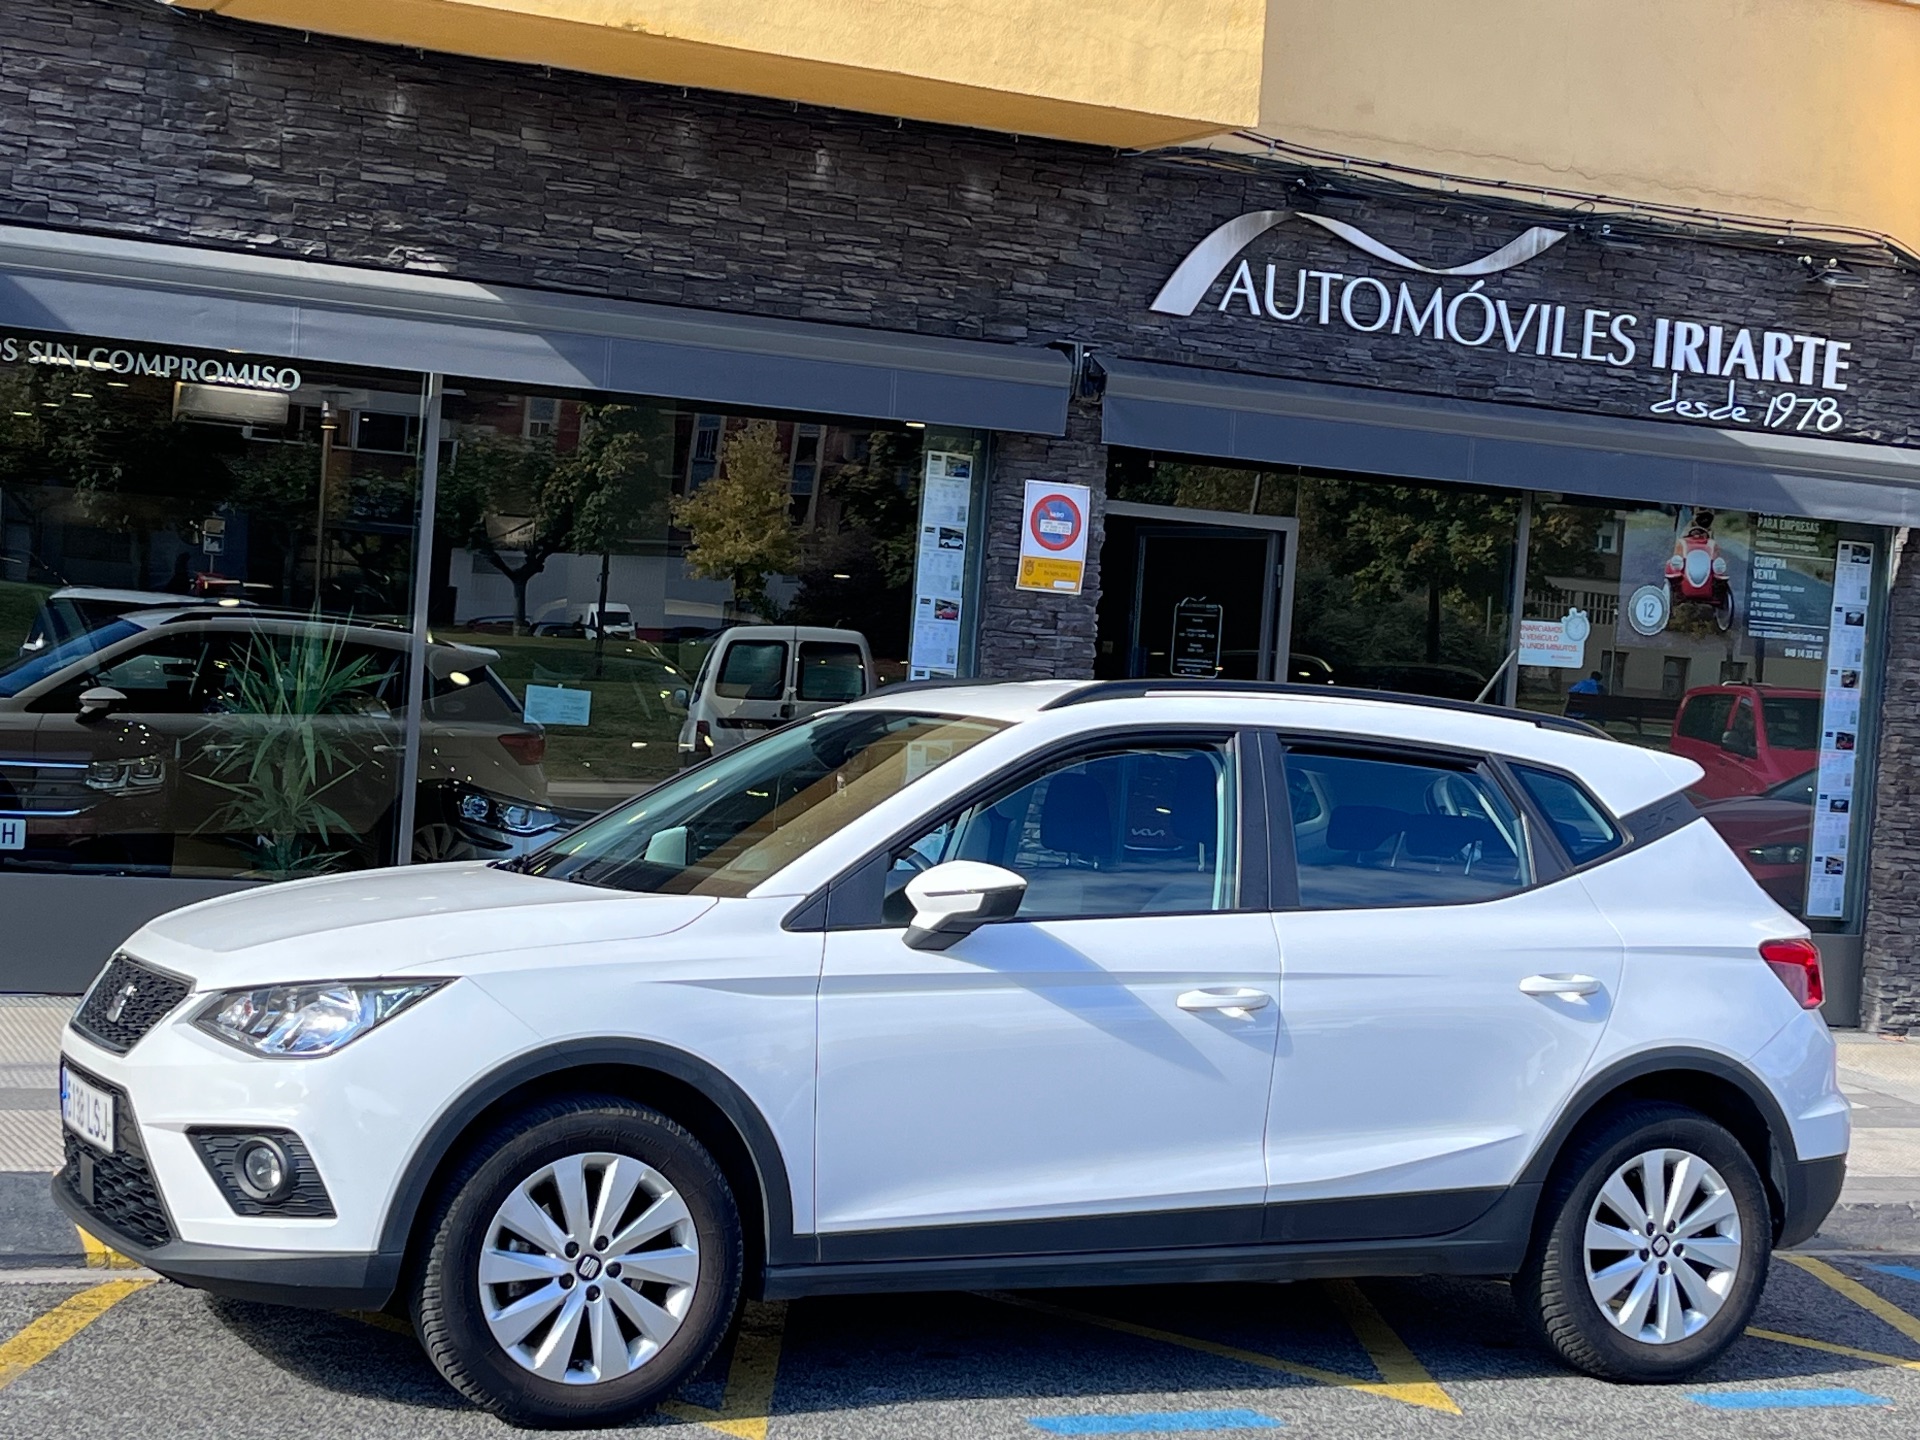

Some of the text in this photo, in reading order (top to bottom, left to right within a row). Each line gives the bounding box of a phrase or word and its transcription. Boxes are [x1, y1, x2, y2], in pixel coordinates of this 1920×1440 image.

[1217, 258, 1852, 391] AUTOMÓVILES IRIARTE
[0, 337, 302, 392] S SIN COMPROMISO
[1650, 372, 1843, 433] desde 1978
[1754, 557, 1787, 570] COMPRA
[1754, 569, 1777, 581] VENTA
[1643, 602, 1656, 618] 12
[87, 1093, 109, 1142] LSJ
